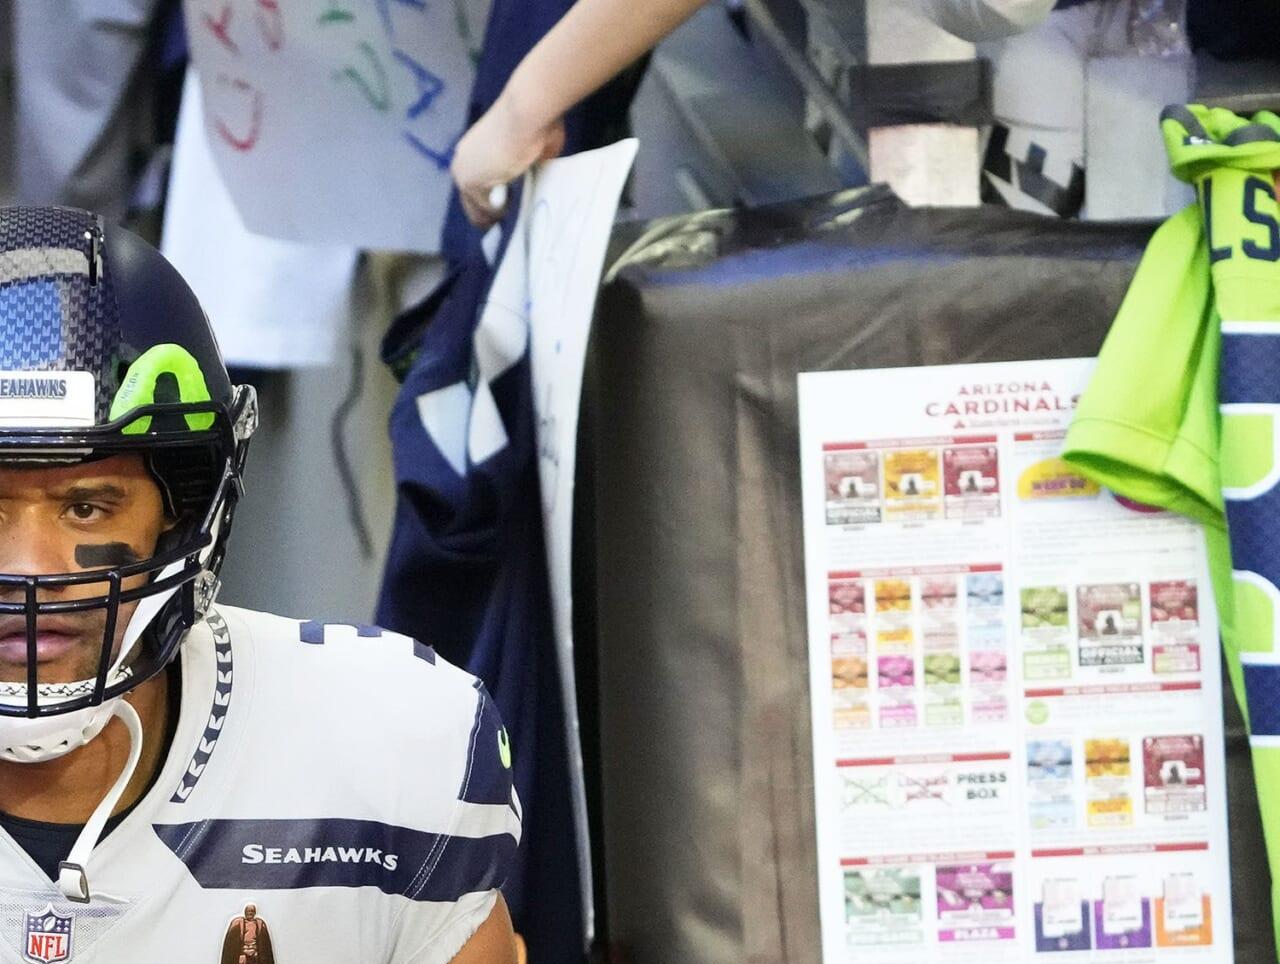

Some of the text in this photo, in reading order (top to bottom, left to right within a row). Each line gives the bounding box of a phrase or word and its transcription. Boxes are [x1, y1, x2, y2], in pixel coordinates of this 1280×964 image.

[958, 381, 1052, 396] ARIZONA
[956, 771, 1008, 785] PRESS
[966, 788, 999, 800] BOX
[30, 934, 65, 960] NFL
